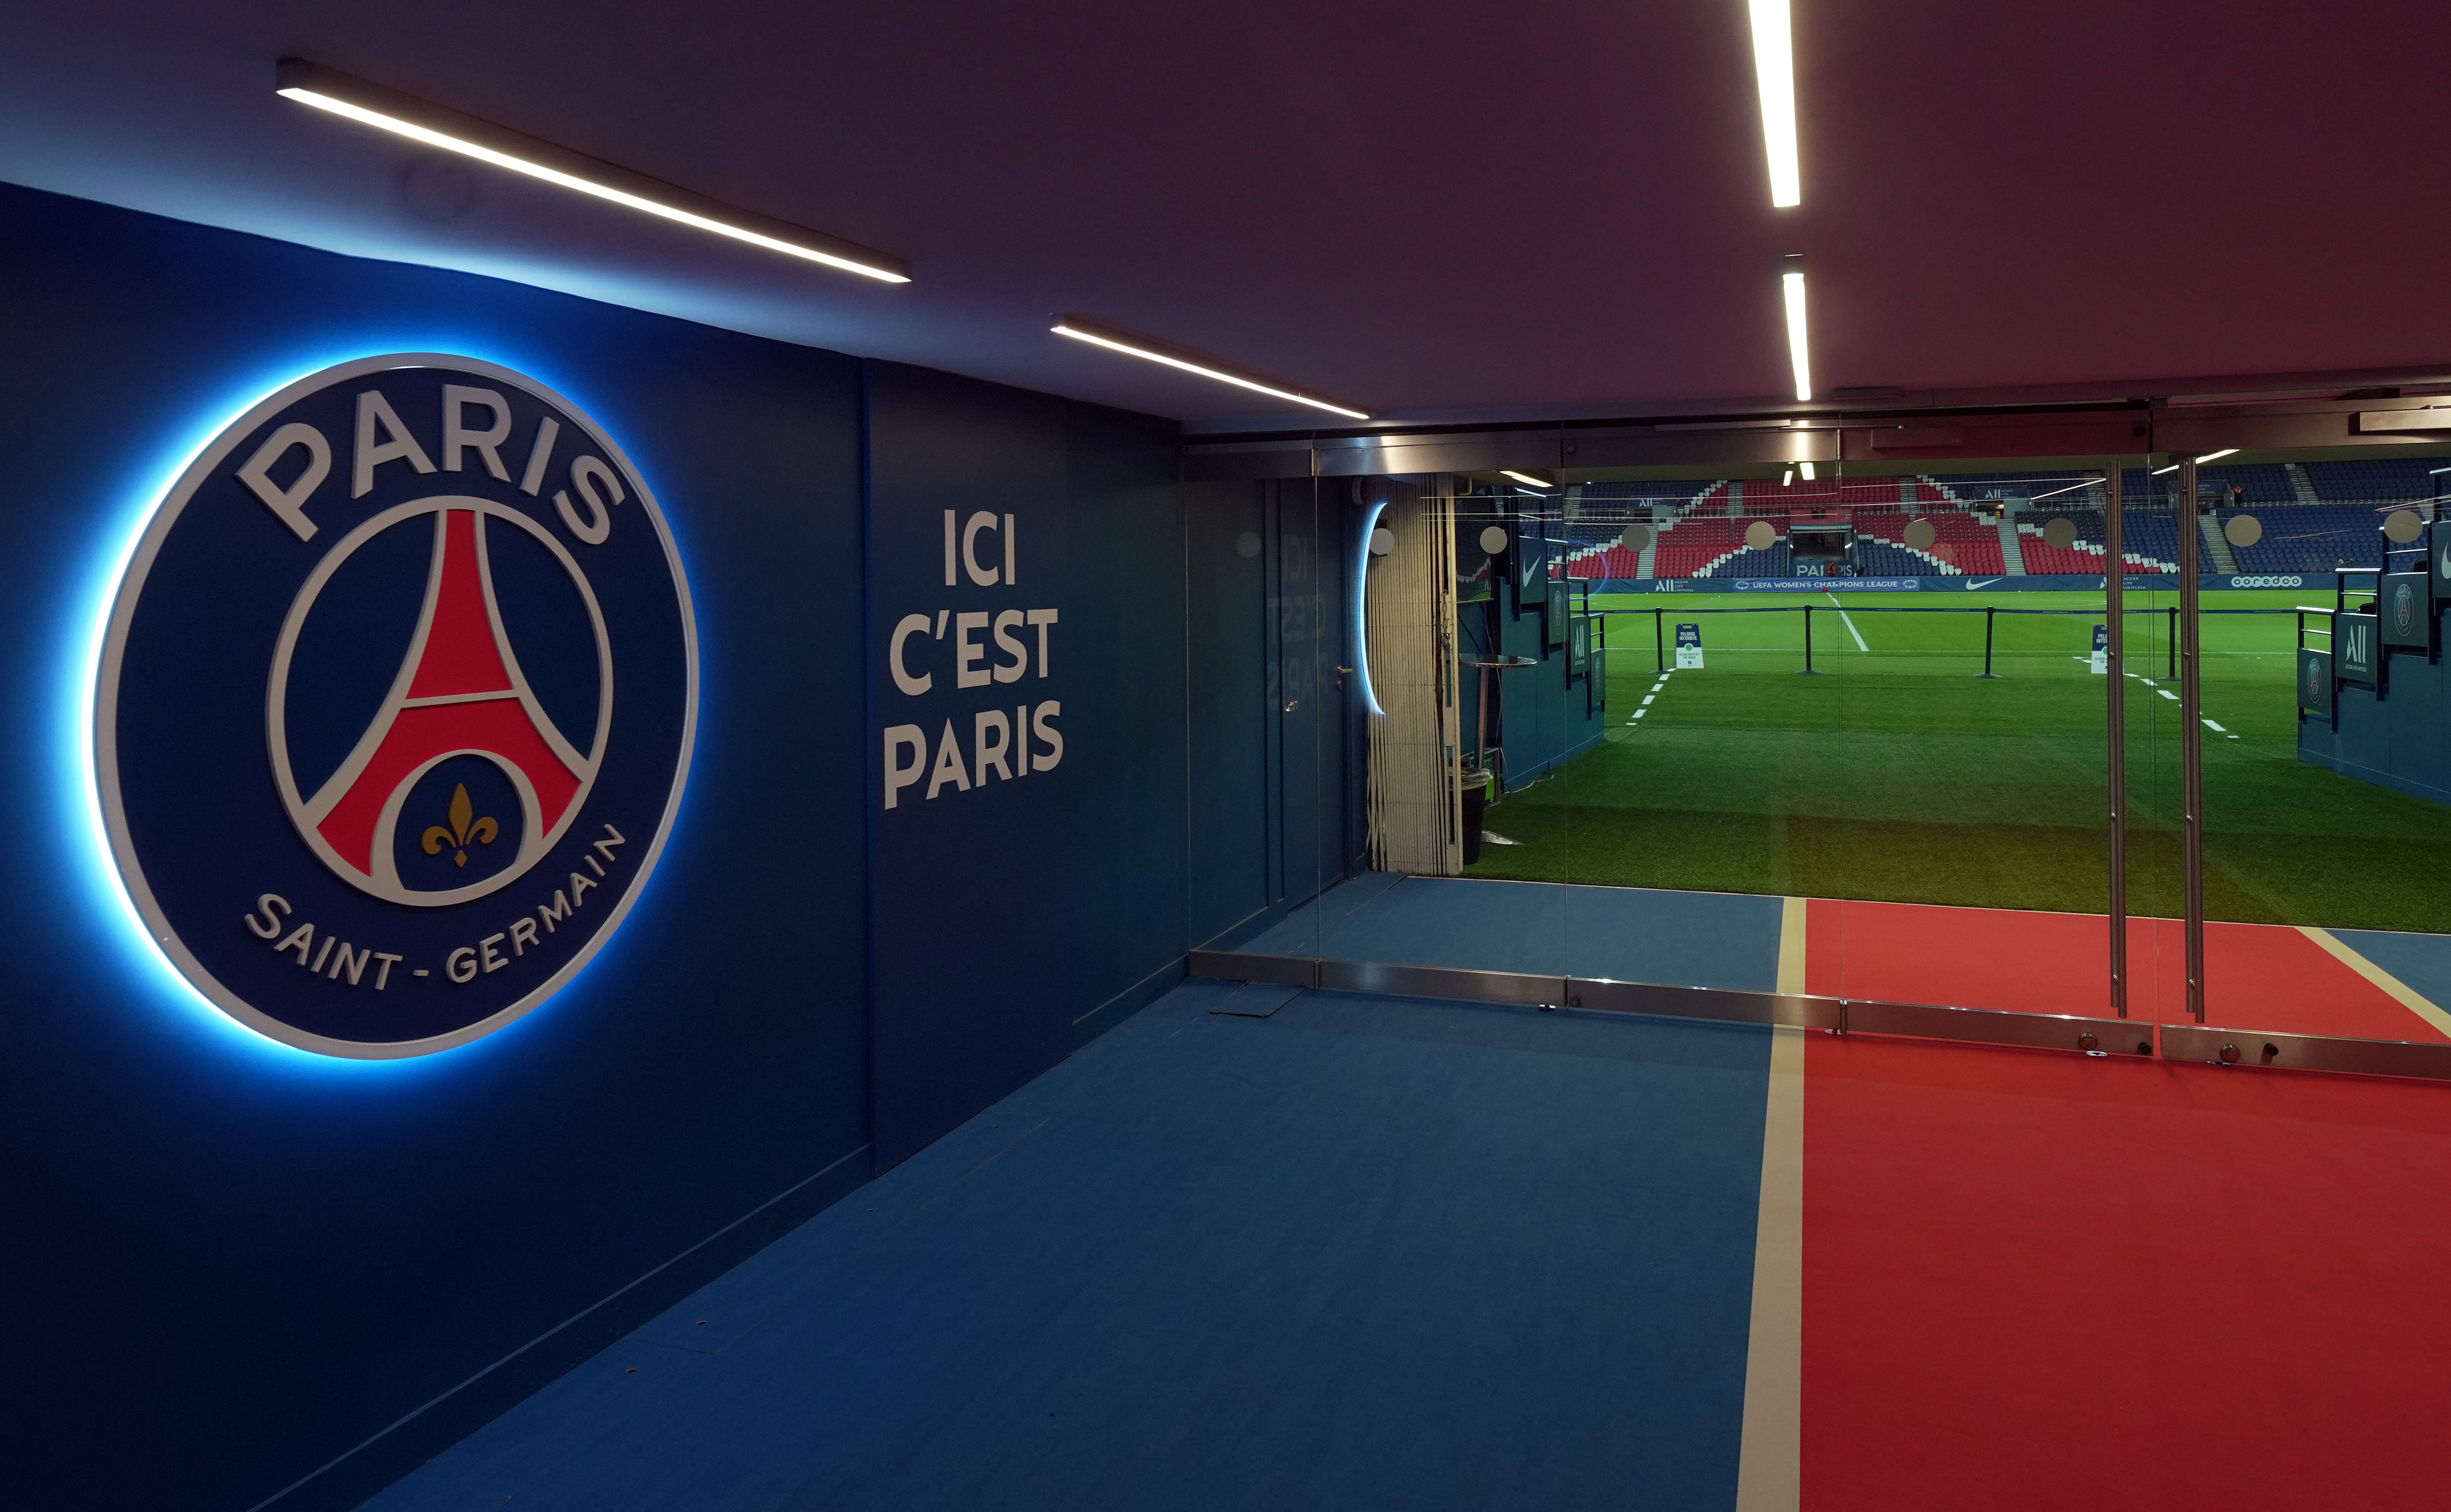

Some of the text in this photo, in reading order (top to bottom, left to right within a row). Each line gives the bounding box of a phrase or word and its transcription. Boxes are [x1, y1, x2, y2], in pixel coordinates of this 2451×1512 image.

[235, 383, 625, 545] PARIS
[945, 509, 1015, 587] ICI
[2232, 577, 2301, 586] ooredoo
[890, 608, 1058, 696] C'EST
[884, 700, 1063, 810] PARIS
